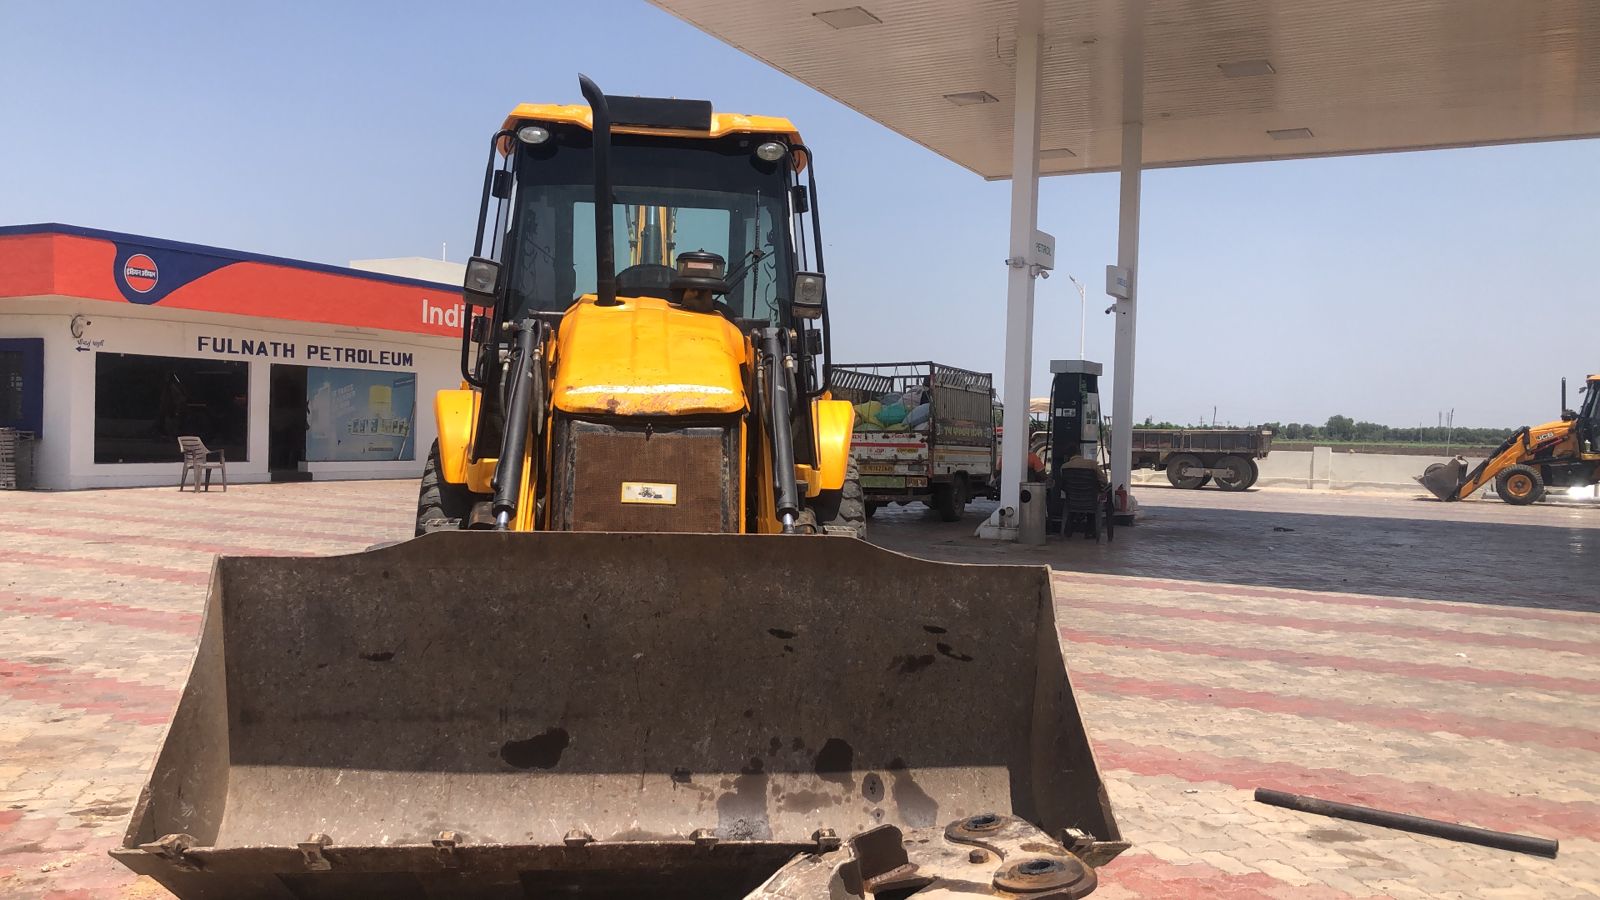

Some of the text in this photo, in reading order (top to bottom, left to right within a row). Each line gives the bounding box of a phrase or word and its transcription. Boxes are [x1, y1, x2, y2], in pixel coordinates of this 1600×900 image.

[422, 299, 480, 329] Indi
[197, 336, 413, 366] FULNATH PETROLEUM
[1536, 432, 1554, 441] JCB
